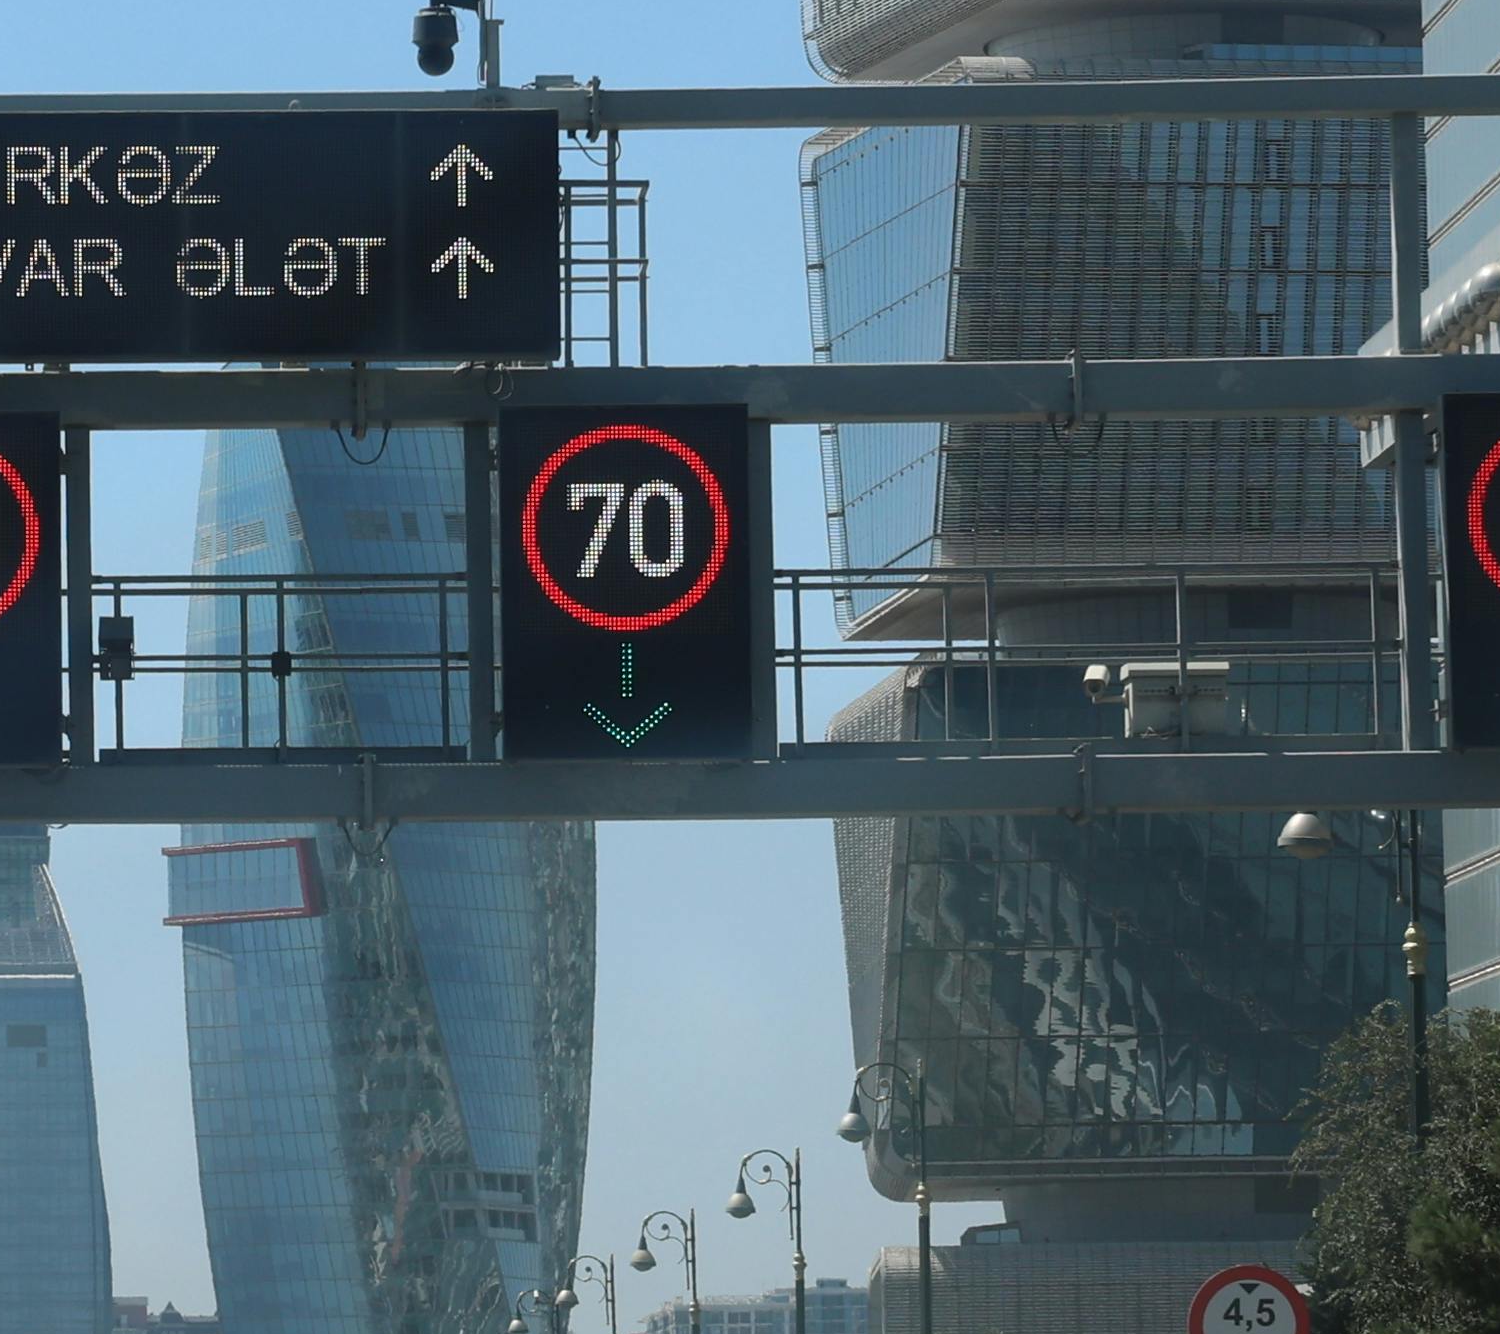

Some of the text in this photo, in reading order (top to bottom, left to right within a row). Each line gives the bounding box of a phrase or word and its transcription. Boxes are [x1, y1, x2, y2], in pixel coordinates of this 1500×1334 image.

[176, 237, 387, 299] ƏLƏT
[567, 477, 686, 579] 70
[1223, 1297, 1276, 1332] 4,5
